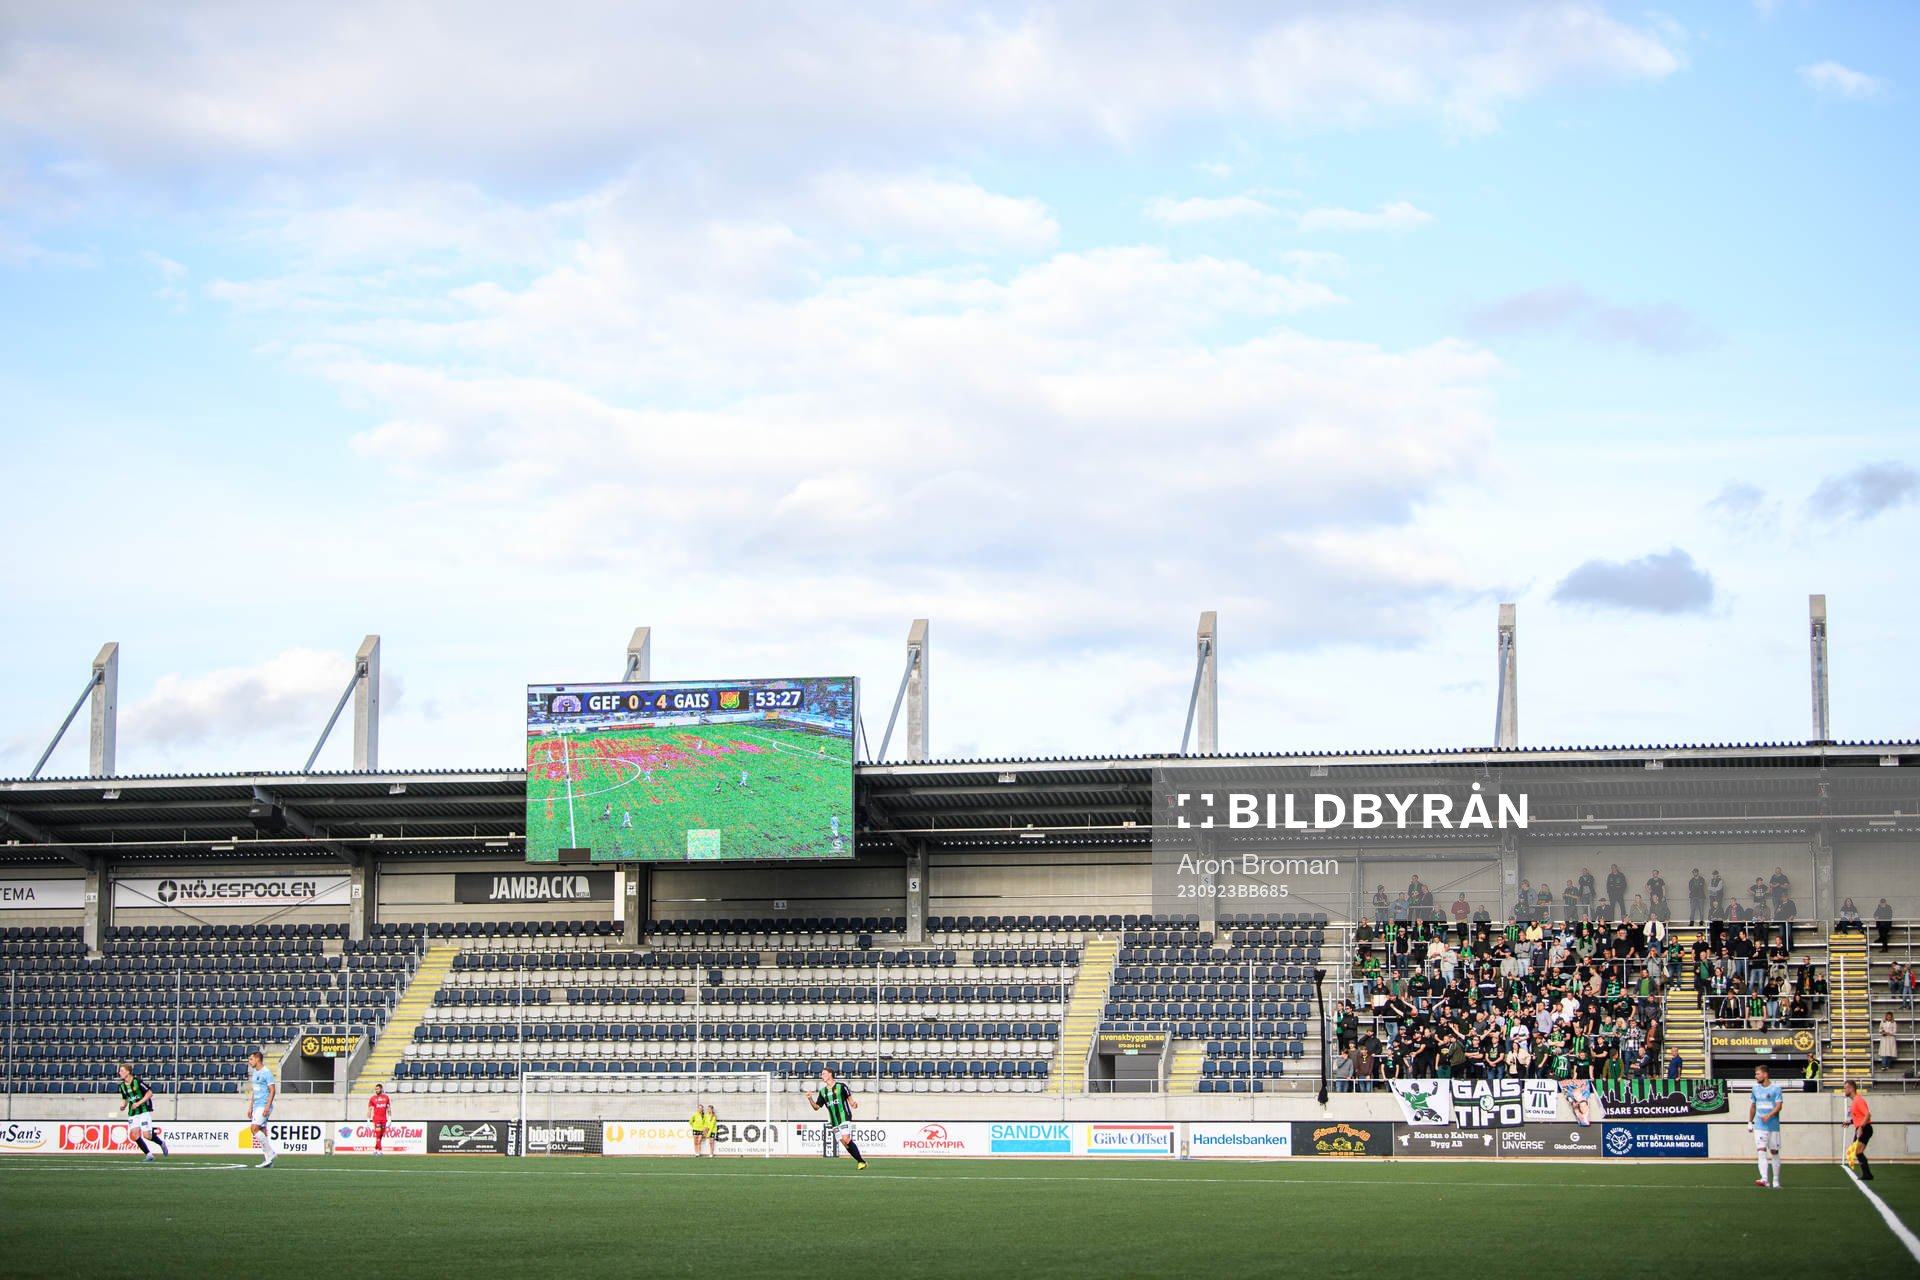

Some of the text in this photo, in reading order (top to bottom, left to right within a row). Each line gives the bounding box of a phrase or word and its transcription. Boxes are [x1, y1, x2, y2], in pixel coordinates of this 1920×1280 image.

[589, 691, 620, 711] GEF
[628, 691, 639, 709] 0
[656, 691, 667, 708] 4
[674, 692, 709, 708] GAIS
[755, 690, 801, 707] 53:27
[180, 880, 315, 898] NÖJESPOOLEN
[489, 876, 574, 899] JAMBACK
[0, 887, 35, 901] EMA
[321, 1036, 334, 1044] Din
[1712, 1037, 1728, 1046] Det
[1730, 1036, 1768, 1046] solklara
[1770, 1036, 1793, 1046] valet
[1453, 1078, 1521, 1099] GAIS
[1454, 1103, 1522, 1128] TIFO
[1634, 1106, 1688, 1115] STOCKHOLM
[163, 1131, 229, 1140] FASTPARTNER
[270, 1125, 321, 1140] SEHED
[440, 1124, 464, 1136] AC
[528, 1126, 585, 1142] högström
[851, 1130, 886, 1142] ERSBO
[991, 1125, 1069, 1139] SANDVIK
[1502, 1132, 1526, 1140] OPEN
[1094, 1132, 1167, 1145] Gävle Offset
[1193, 1134, 1287, 1145] Handelsbanken
[1430, 1140, 1450, 1149] Bygg
[283, 1142, 308, 1152] bygg
[903, 1141, 965, 1149] PROLYMPIA
